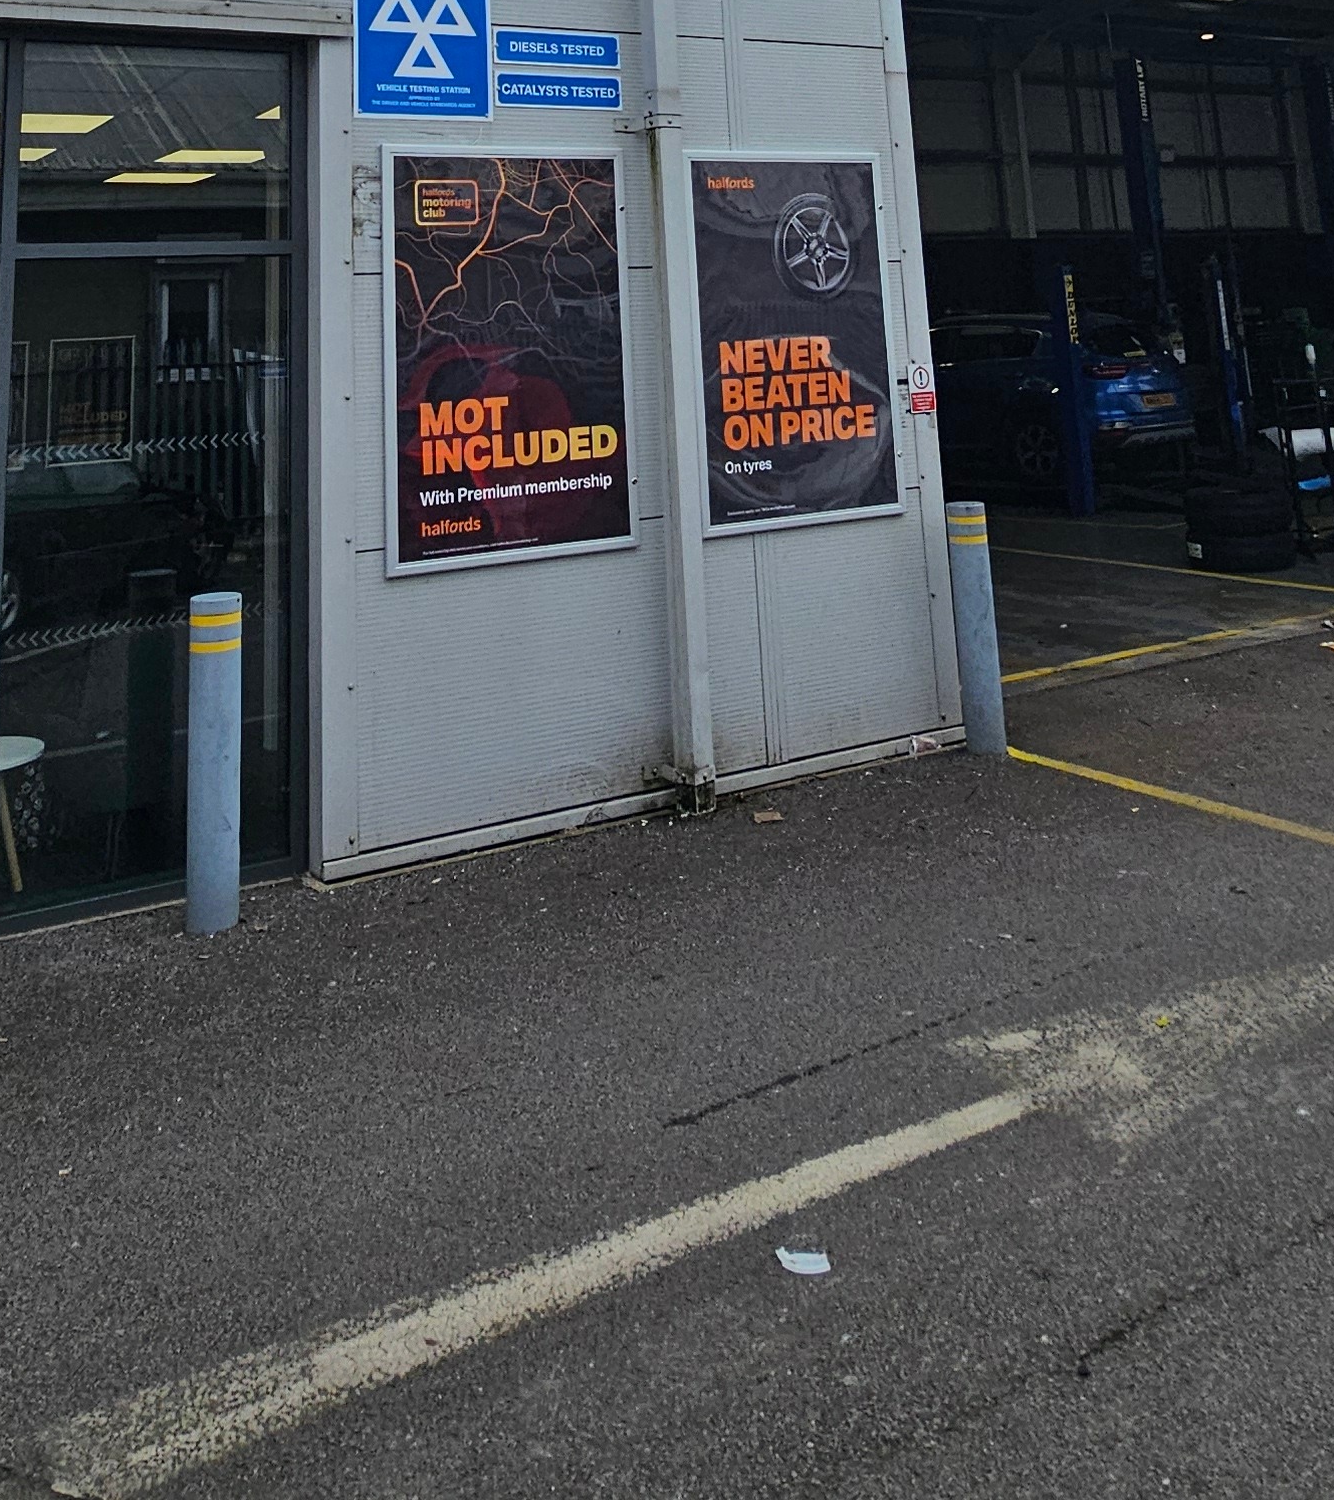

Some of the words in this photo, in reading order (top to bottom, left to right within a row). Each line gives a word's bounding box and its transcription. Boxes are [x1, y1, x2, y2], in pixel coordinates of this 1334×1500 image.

[510, 41, 558, 55] DIESELS
[561, 43, 605, 57] TESTED
[376, 83, 408, 93] VEHICLE
[409, 85, 439, 94] TESTING
[441, 86, 470, 95] STATION
[501, 82, 568, 98] CATALYSTS
[571, 85, 616, 100] TESTED
[707, 176, 755, 190] halfords
[422, 197, 472, 209] motoring
[423, 207, 446, 218] club
[719, 336, 832, 375] NEVER
[722, 370, 851, 412] BEATEN
[420, 396, 509, 438] MOT
[724, 412, 774, 450] ON
[780, 404, 877, 445] PRICE
[422, 424, 618, 476] INCLUDED
[725, 460, 742, 475] On
[743, 458, 772, 475] tyres
[420, 490, 455, 507] With
[458, 483, 523, 504] Premium
[525, 472, 613, 497] membership
[421, 516, 482, 537] halfords
